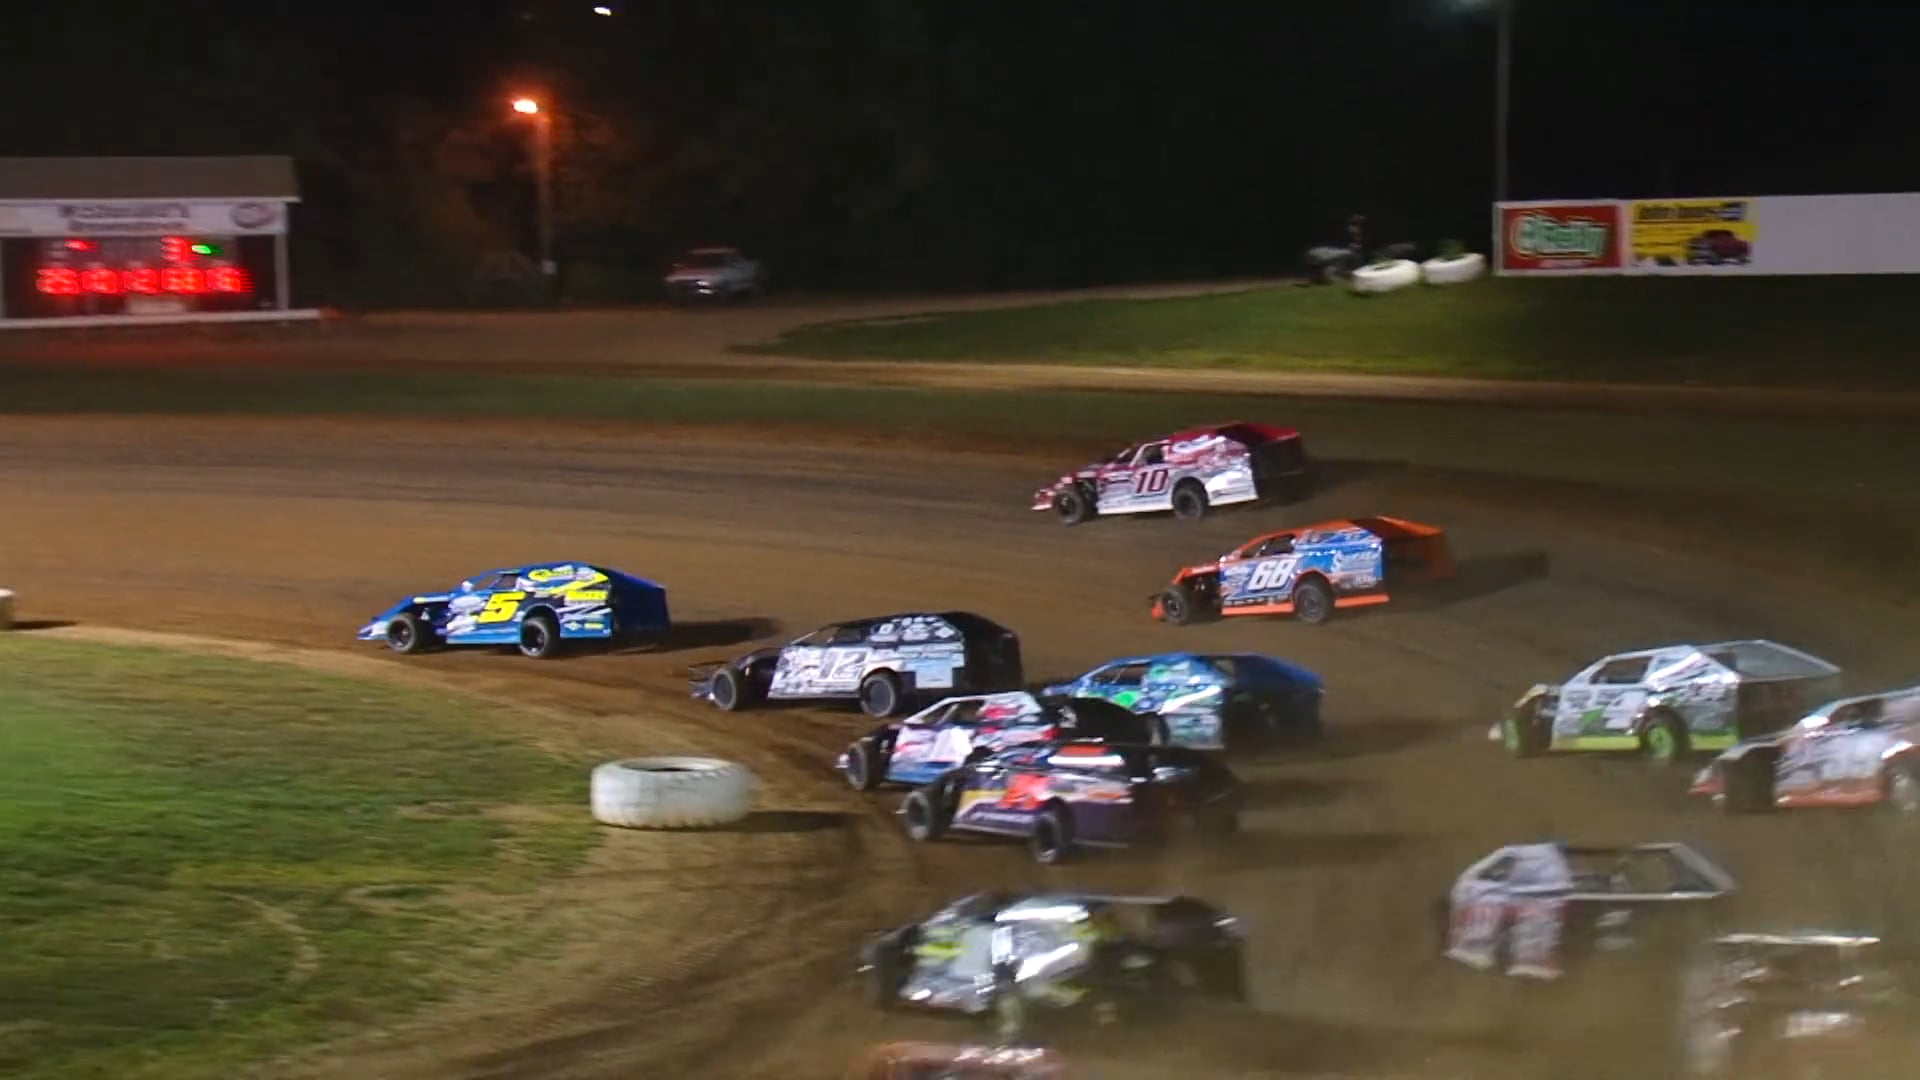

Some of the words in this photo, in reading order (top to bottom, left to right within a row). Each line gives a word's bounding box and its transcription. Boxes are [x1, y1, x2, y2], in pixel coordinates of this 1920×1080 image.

[1135, 468, 1169, 495] 10
[1247, 559, 1297, 592] 68
[476, 591, 527, 624] 5
